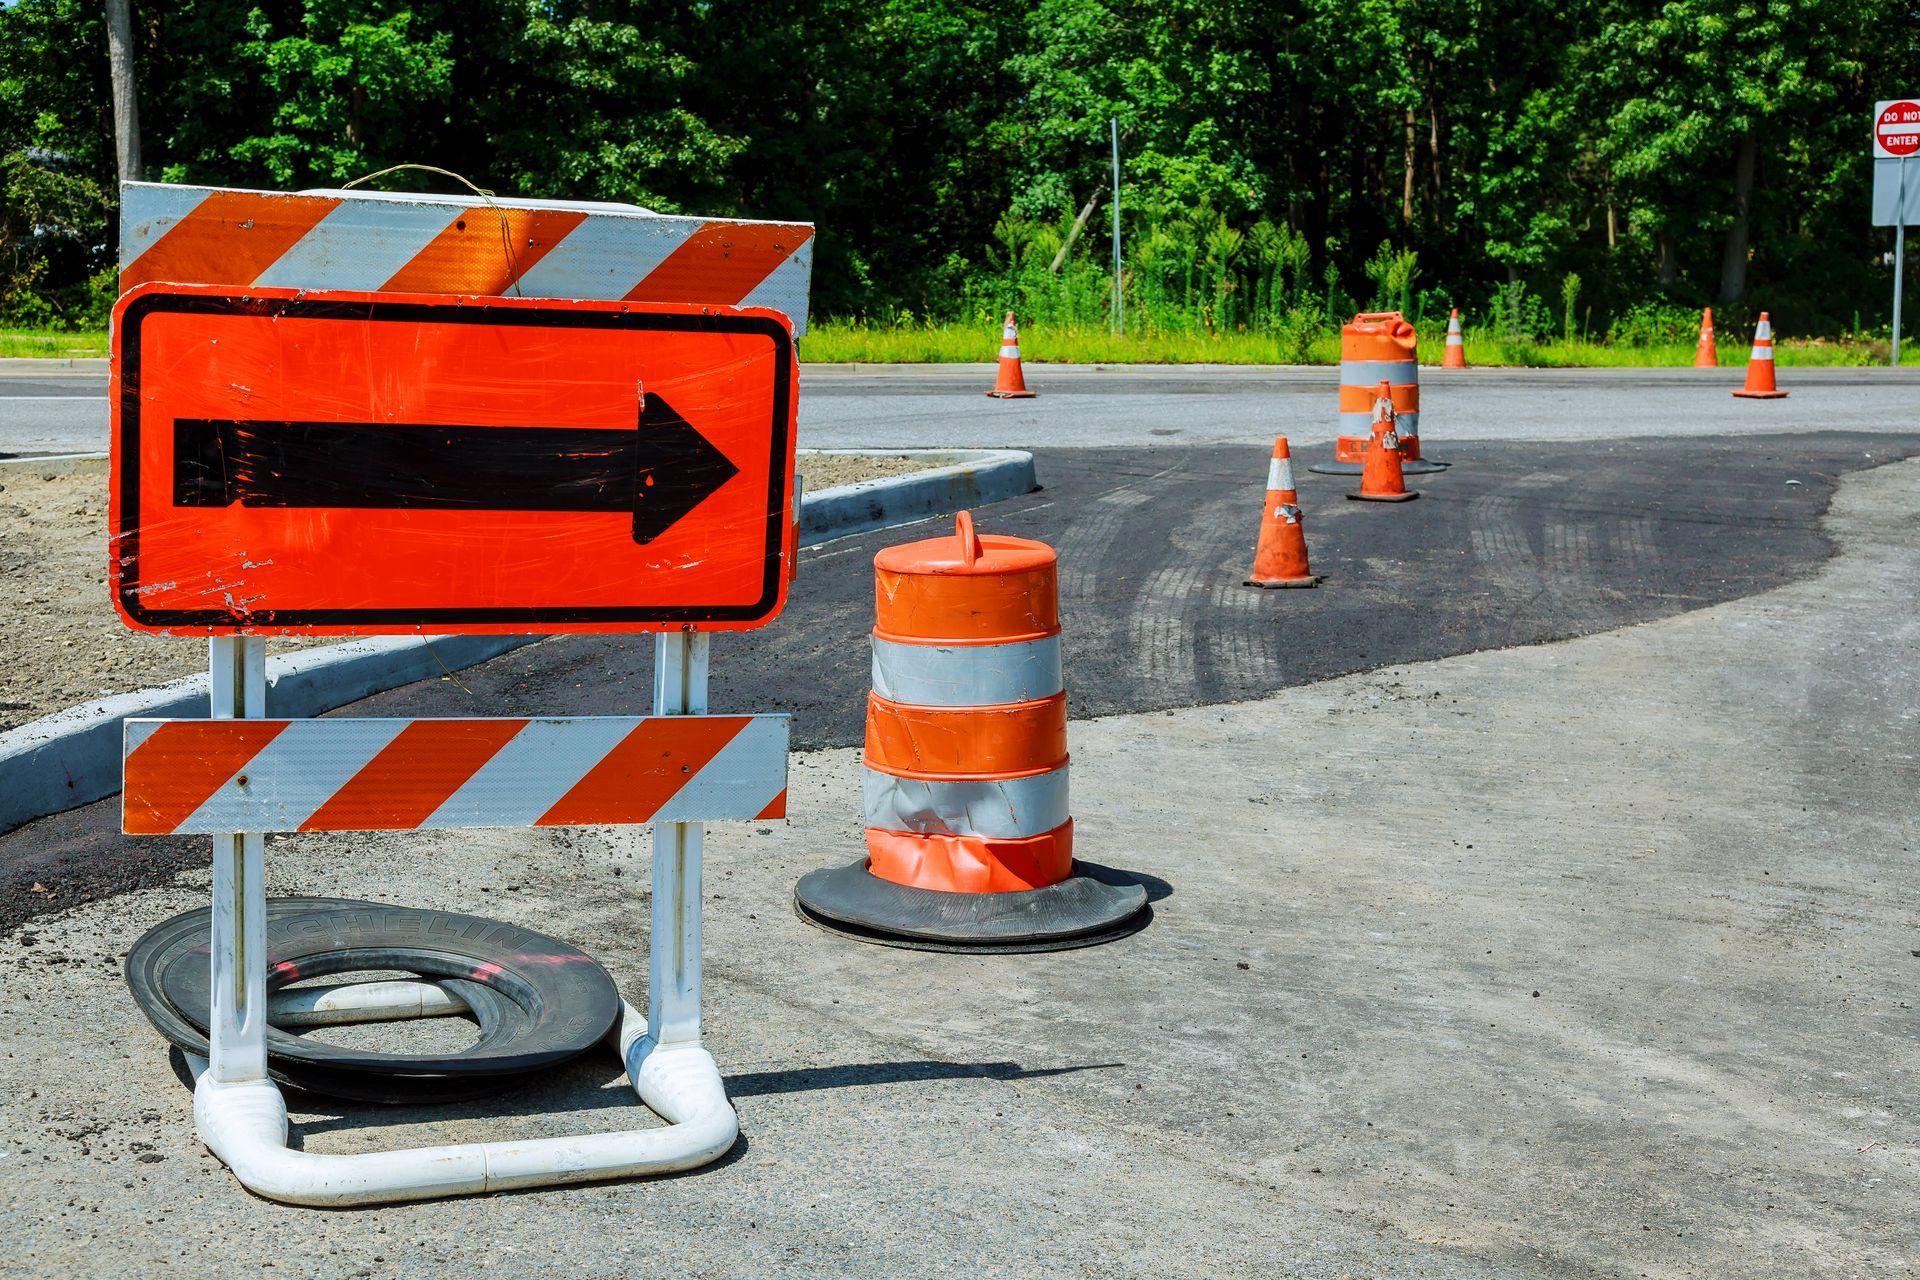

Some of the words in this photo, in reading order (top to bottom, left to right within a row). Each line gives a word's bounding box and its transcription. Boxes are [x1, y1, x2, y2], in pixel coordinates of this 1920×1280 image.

[1883, 112, 1898, 122] DO
[1886, 136, 1918, 146] ENTER
[266, 913, 534, 952] ICHELIN
